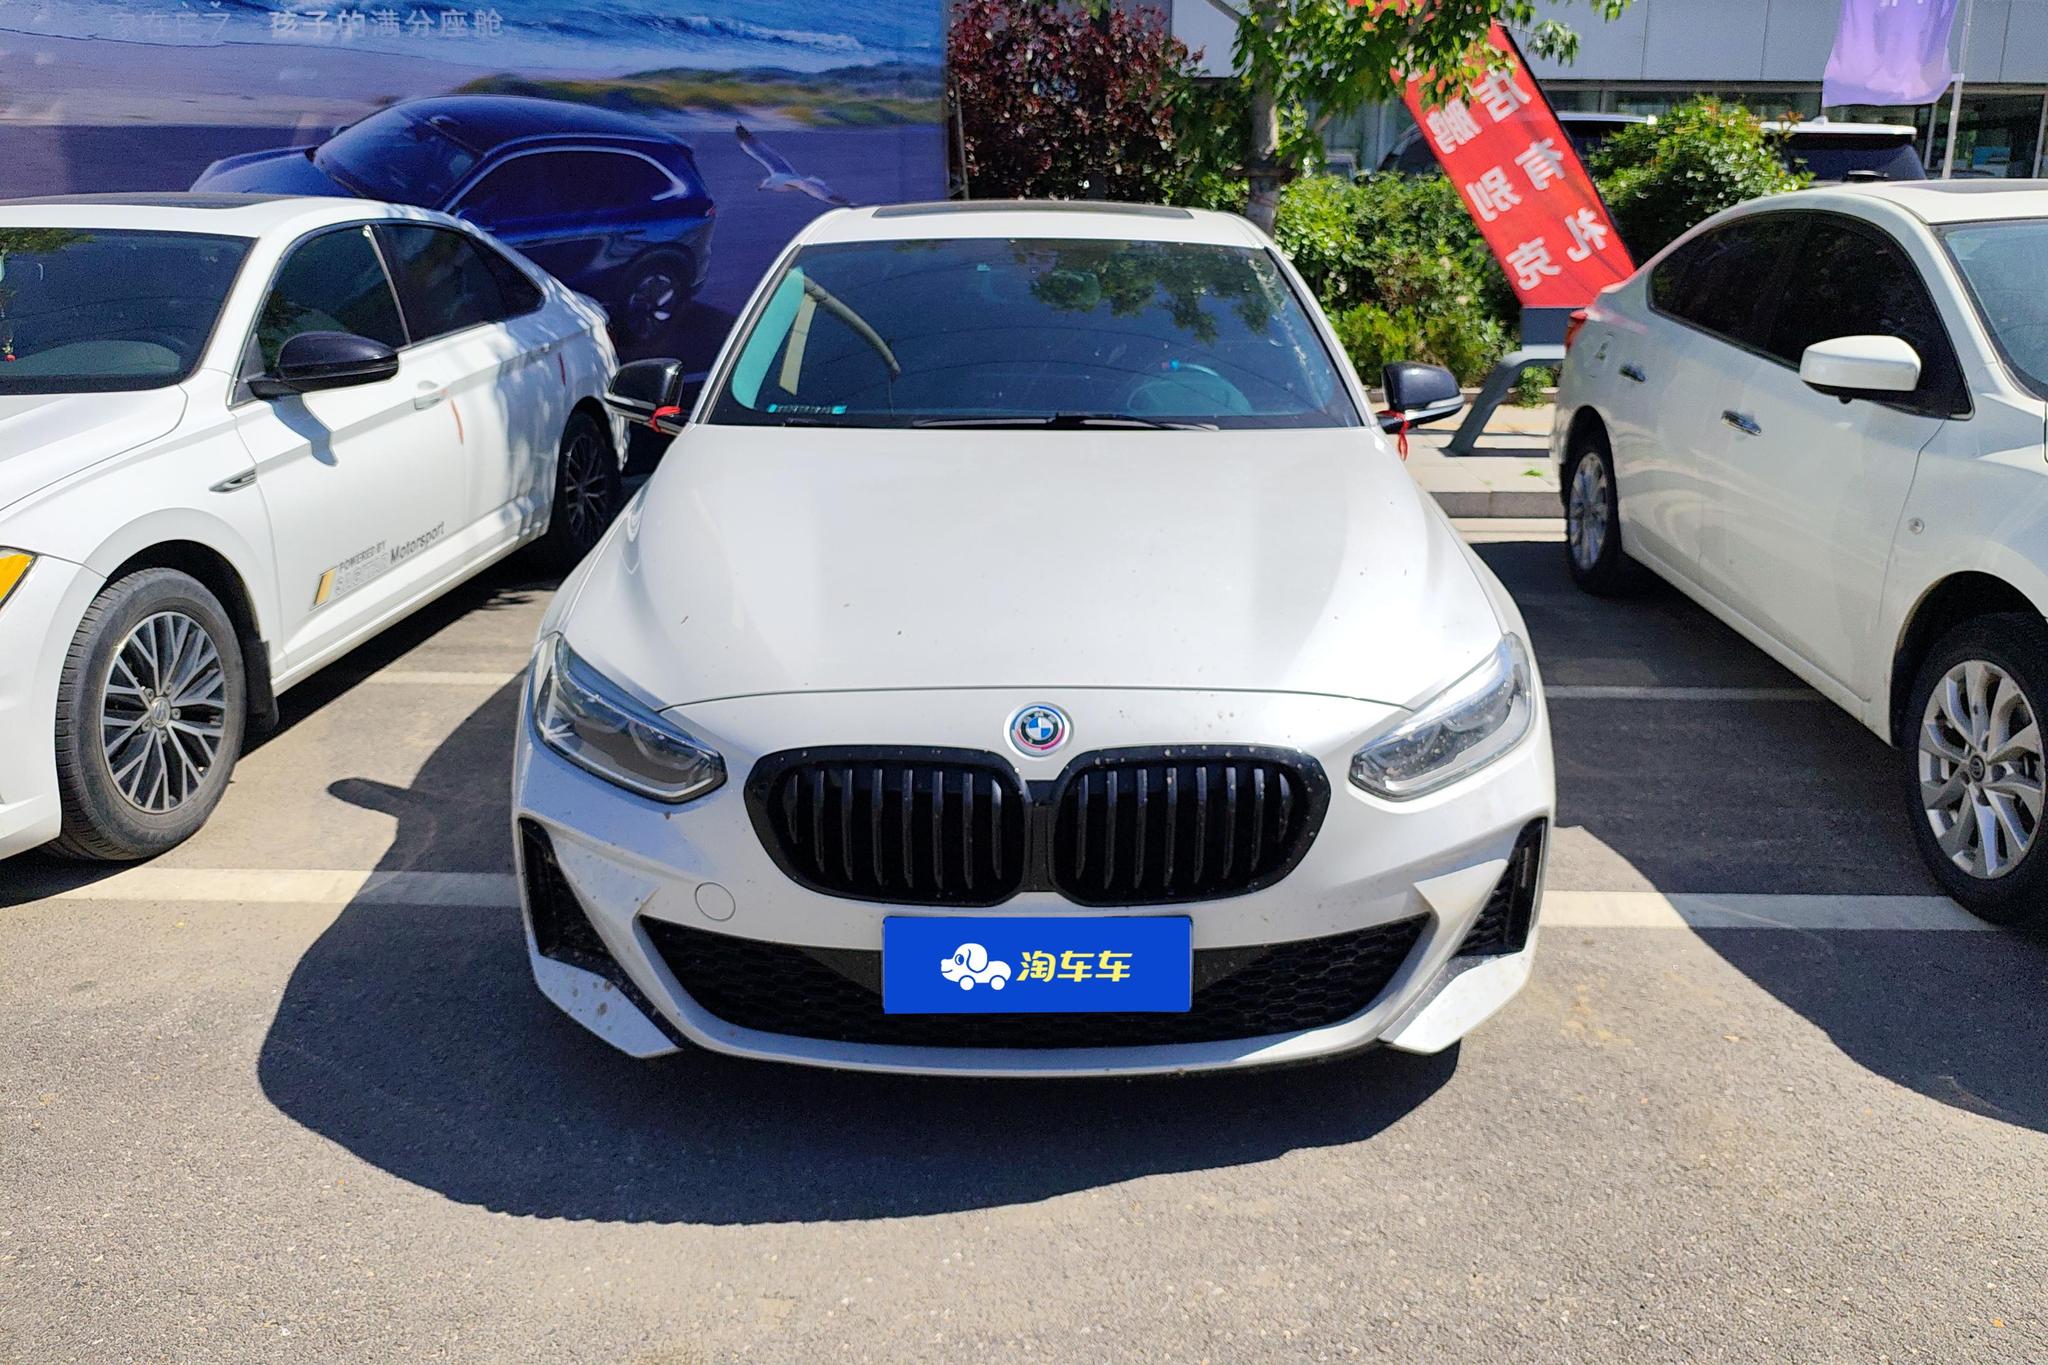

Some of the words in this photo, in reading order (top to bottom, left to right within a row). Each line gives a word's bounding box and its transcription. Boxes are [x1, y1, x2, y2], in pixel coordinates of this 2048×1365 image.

[268, 8, 504, 38] 孩子的满分座舱
[389, 520, 445, 565] Motorsport
